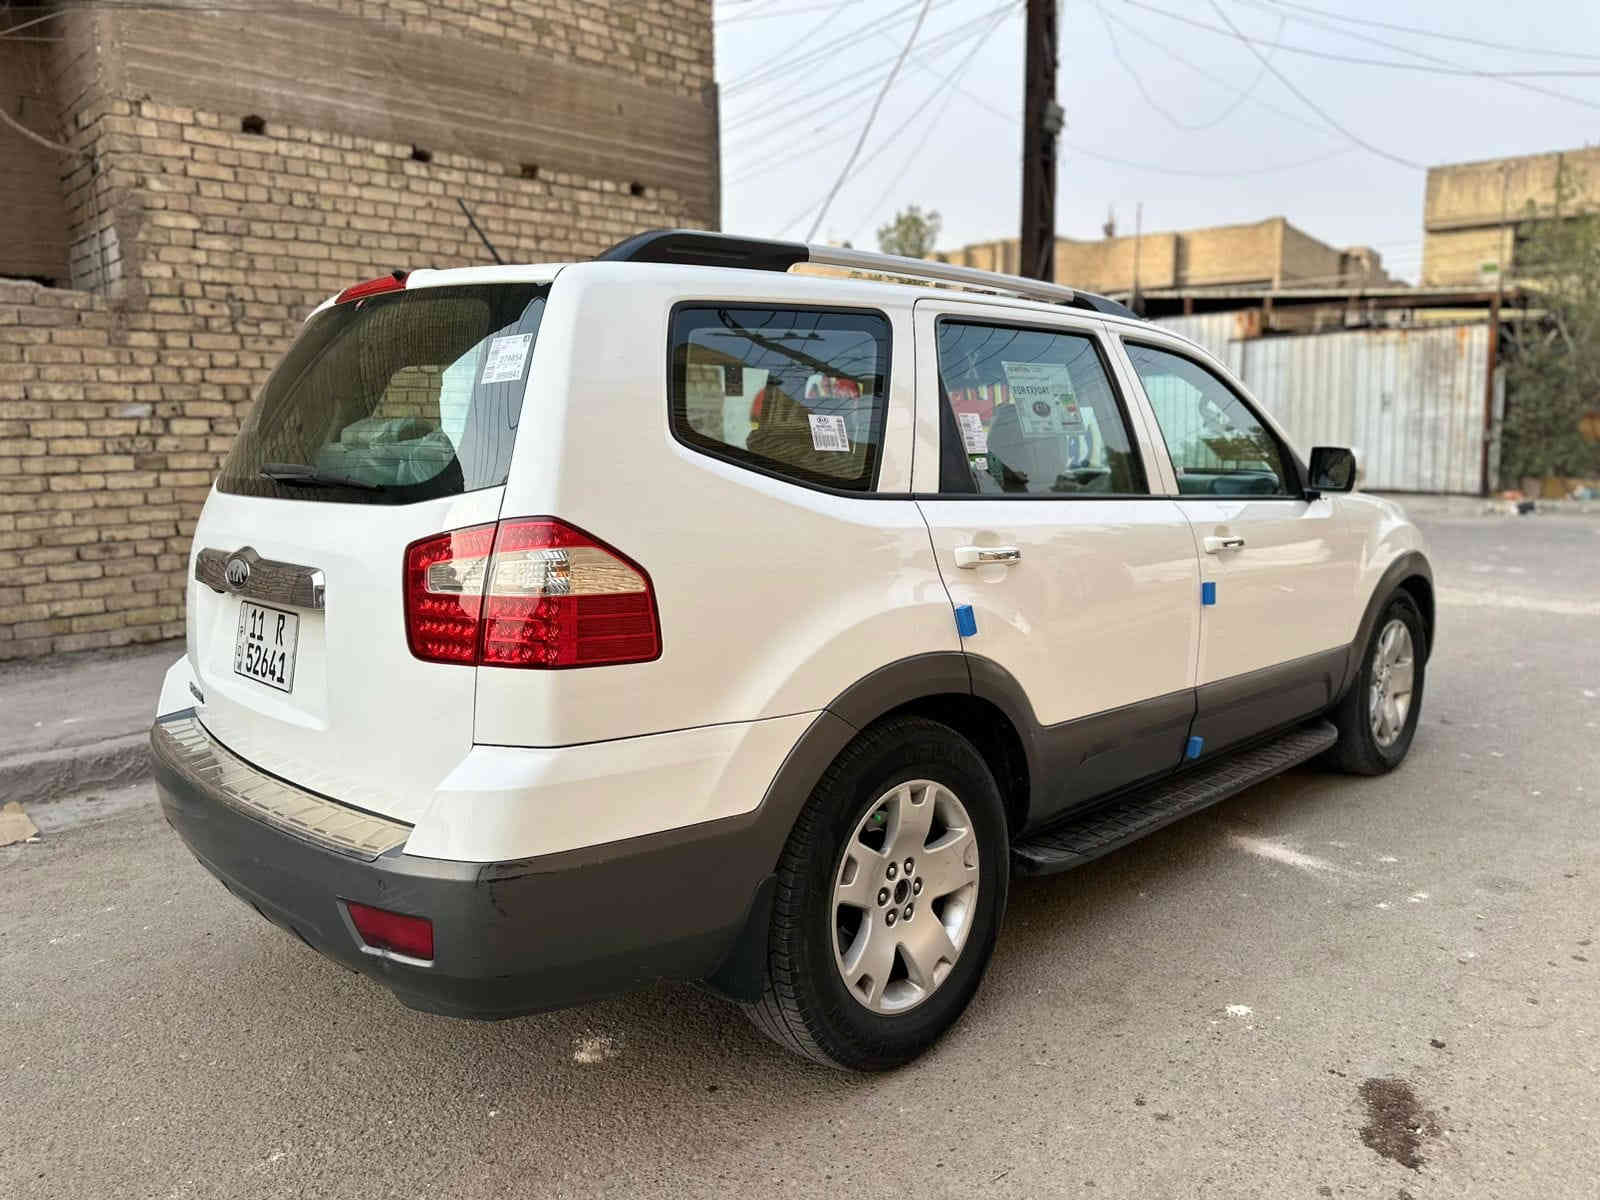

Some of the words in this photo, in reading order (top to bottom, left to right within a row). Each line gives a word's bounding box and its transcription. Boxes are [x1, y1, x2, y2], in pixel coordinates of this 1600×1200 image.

[249, 609, 265, 641] 11
[275, 613, 286, 646] R
[245, 642, 286, 684] 52641
